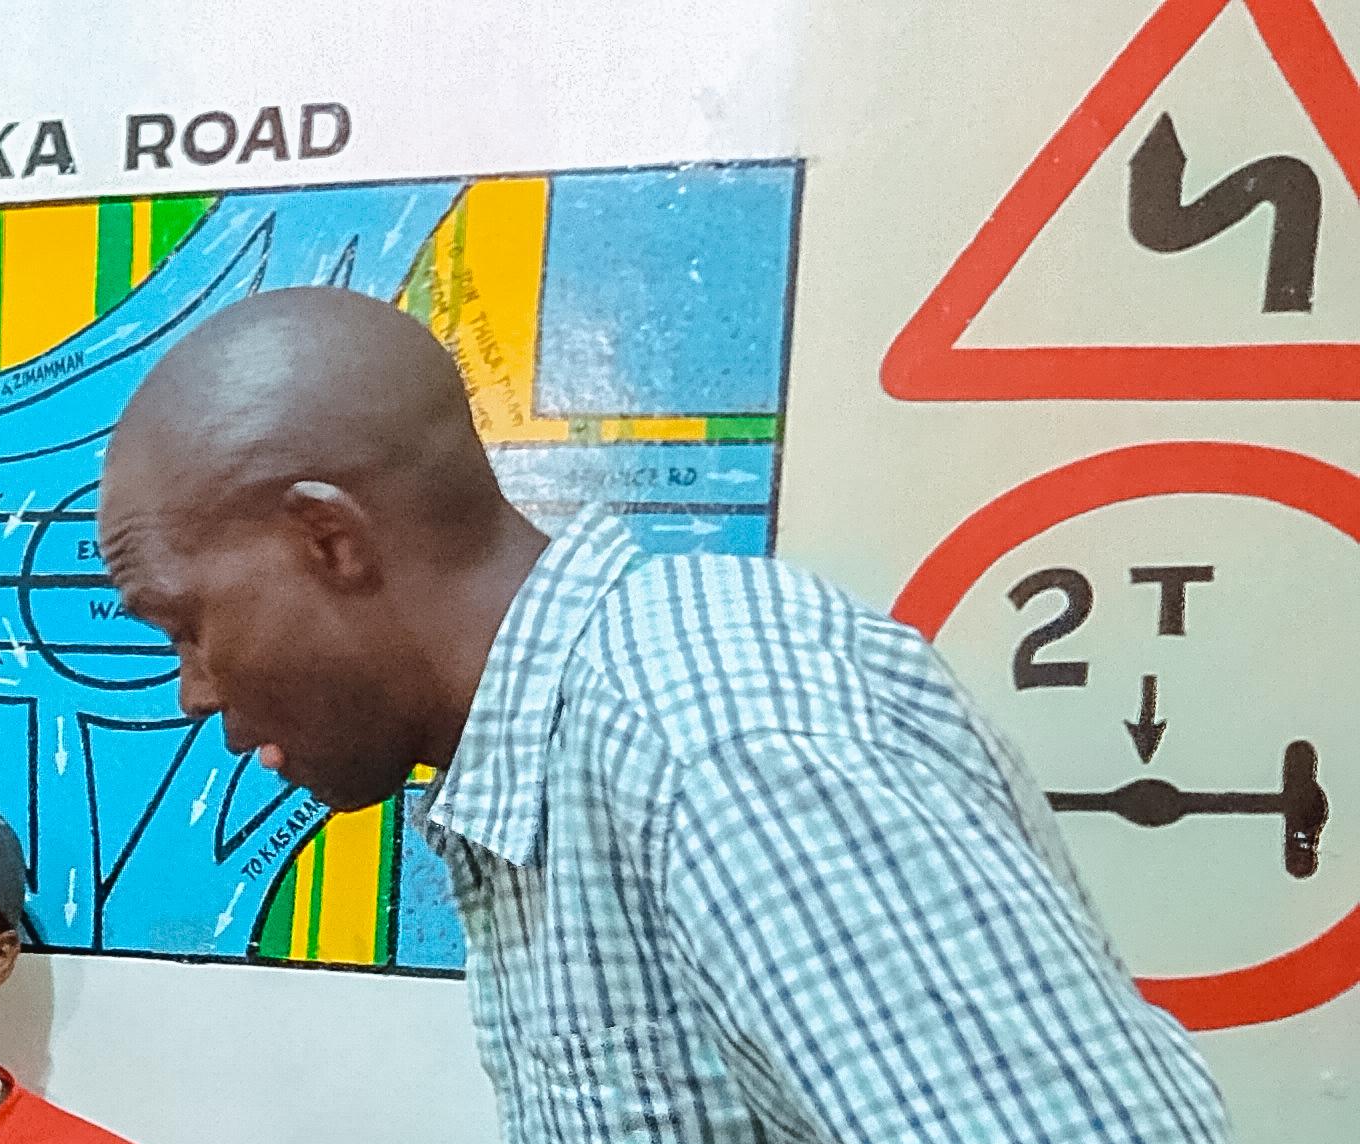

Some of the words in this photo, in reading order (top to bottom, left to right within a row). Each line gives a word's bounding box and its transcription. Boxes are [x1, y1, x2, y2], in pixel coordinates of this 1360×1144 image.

[123, 101, 353, 172] ROAD
[668, 467, 697, 487] RD
[1007, 567, 1095, 690] 2
[1128, 566, 1215, 636] T
[241, 857, 263, 880] TO
[258, 800, 324, 865] KASARA
